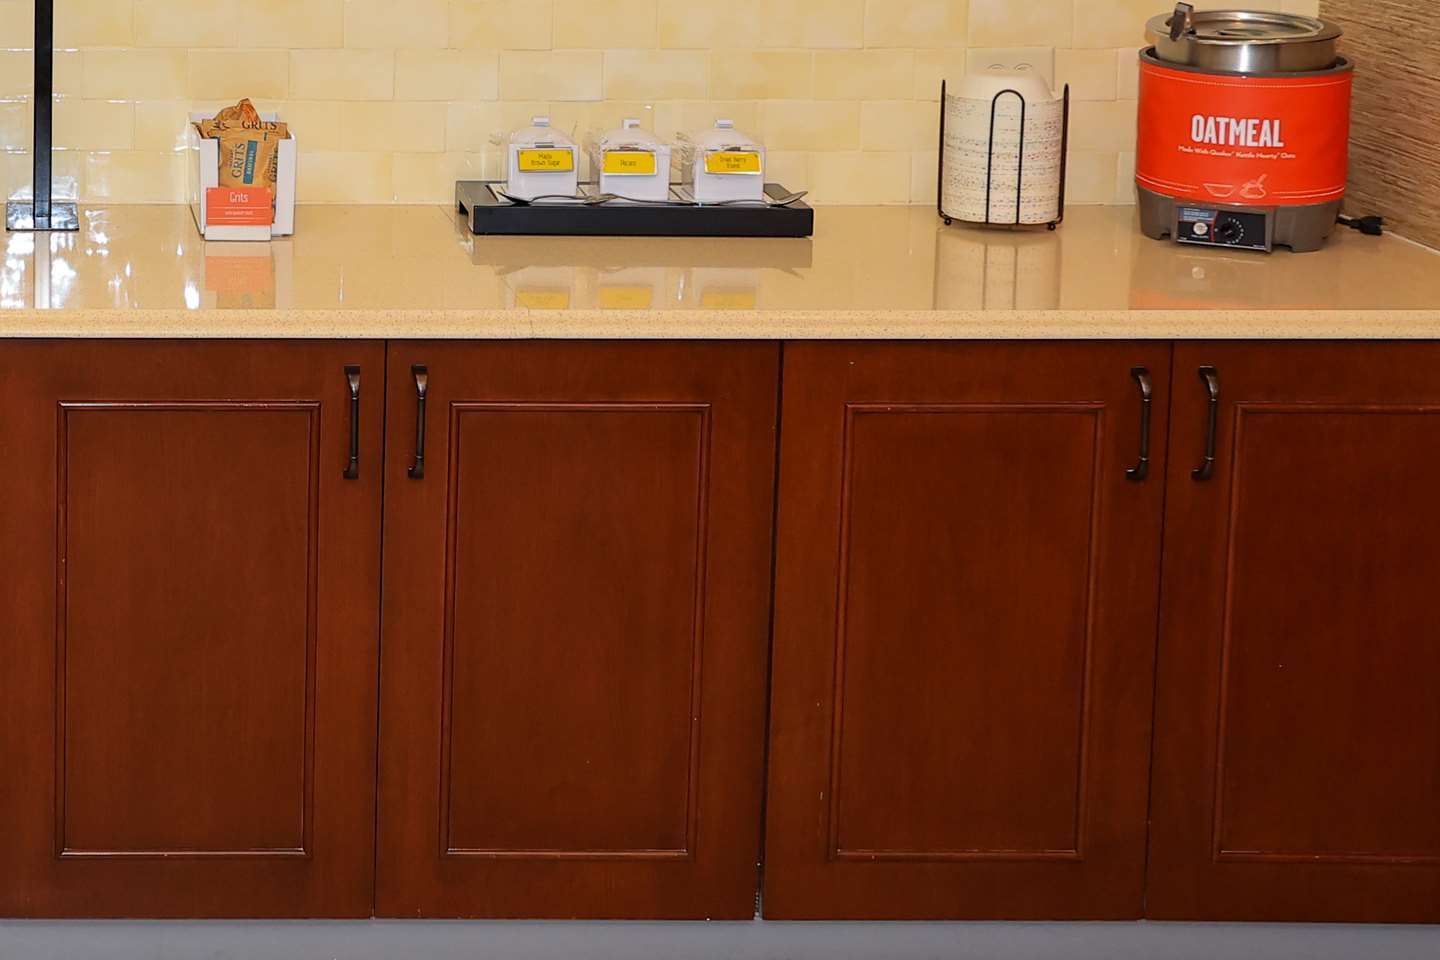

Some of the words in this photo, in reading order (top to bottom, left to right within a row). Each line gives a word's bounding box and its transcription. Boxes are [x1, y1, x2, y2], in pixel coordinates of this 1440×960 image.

[242, 121, 277, 131] GRITS
[1191, 114, 1285, 148] OATMEAL
[231, 143, 246, 178] GRITS
